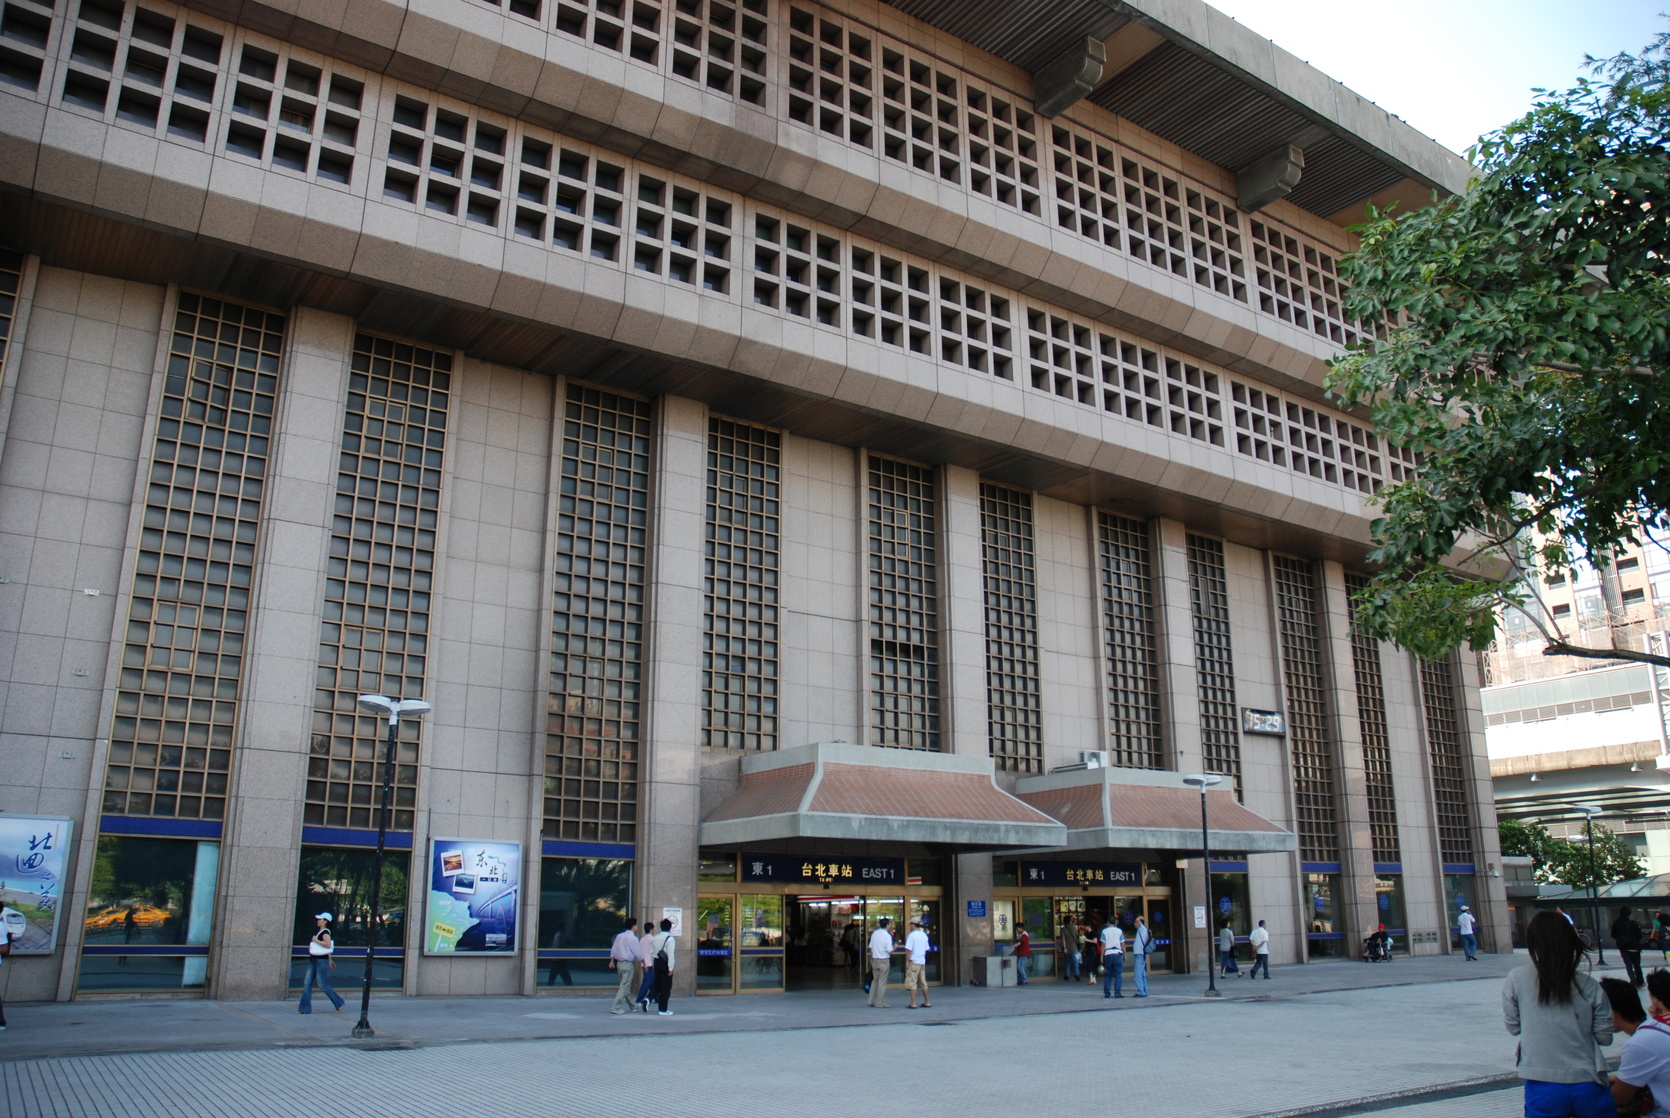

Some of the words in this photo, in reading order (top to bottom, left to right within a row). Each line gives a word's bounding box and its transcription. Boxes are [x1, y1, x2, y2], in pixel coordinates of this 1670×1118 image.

[752, 862, 763, 876] 東
[767, 865, 772, 876] 1
[802, 863, 853, 878] 台北車站
[862, 868, 888, 880] EAST
[889, 869, 895, 880] 1
[1029, 868, 1039, 880] 東
[1066, 868, 1104, 881] 台北車站
[1110, 871, 1129, 882] EAST
[1131, 872, 1136, 882] 1
